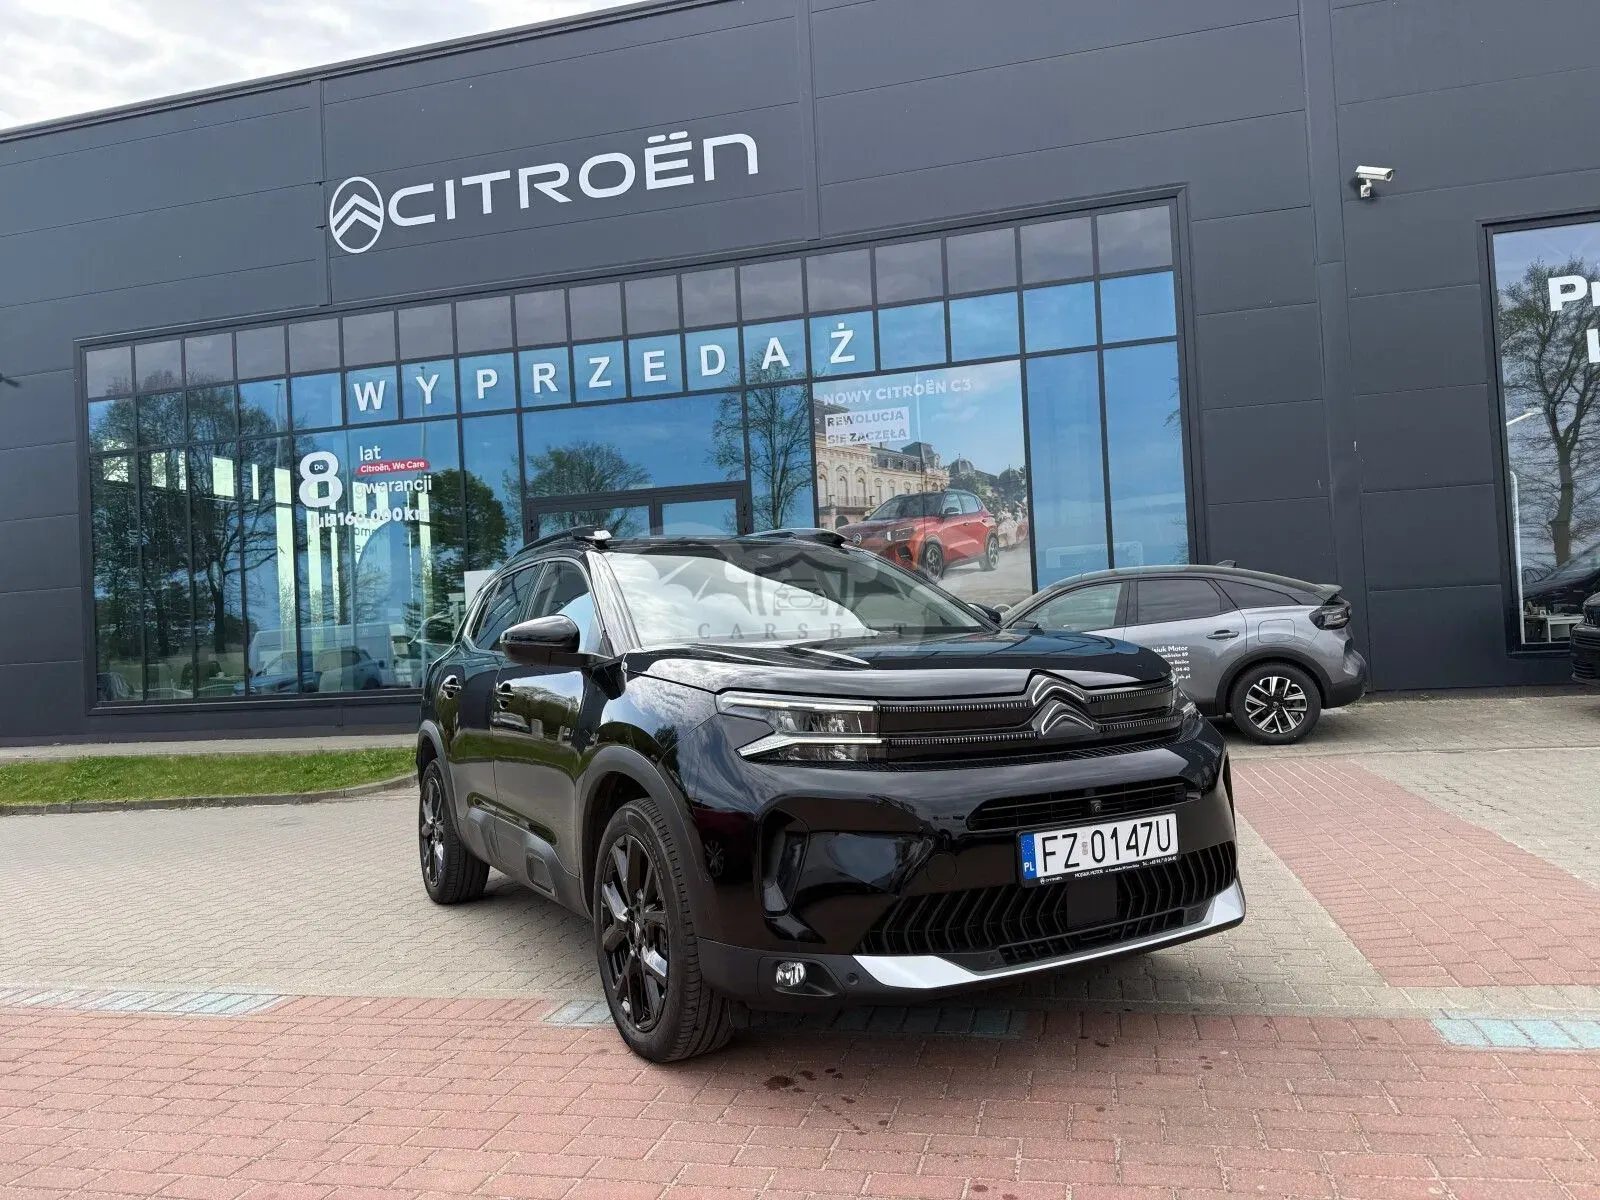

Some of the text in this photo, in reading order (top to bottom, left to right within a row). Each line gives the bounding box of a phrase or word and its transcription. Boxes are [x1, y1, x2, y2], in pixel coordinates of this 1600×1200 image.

[388, 130, 759, 227] CITROËN
[353, 322, 856, 412] WYPRZEDAŻ
[823, 379, 972, 406] NOWY CITROËN C3
[827, 410, 904, 427] REWOLUCJA
[359, 445, 382, 461] lat
[392, 462, 405, 470] We
[407, 460, 425, 469] Care
[299, 451, 343, 508] 8
[355, 475, 432, 498] gwarancji
[1041, 818, 1171, 872] FZ 0147U
[1024, 862, 1035, 872] PL
